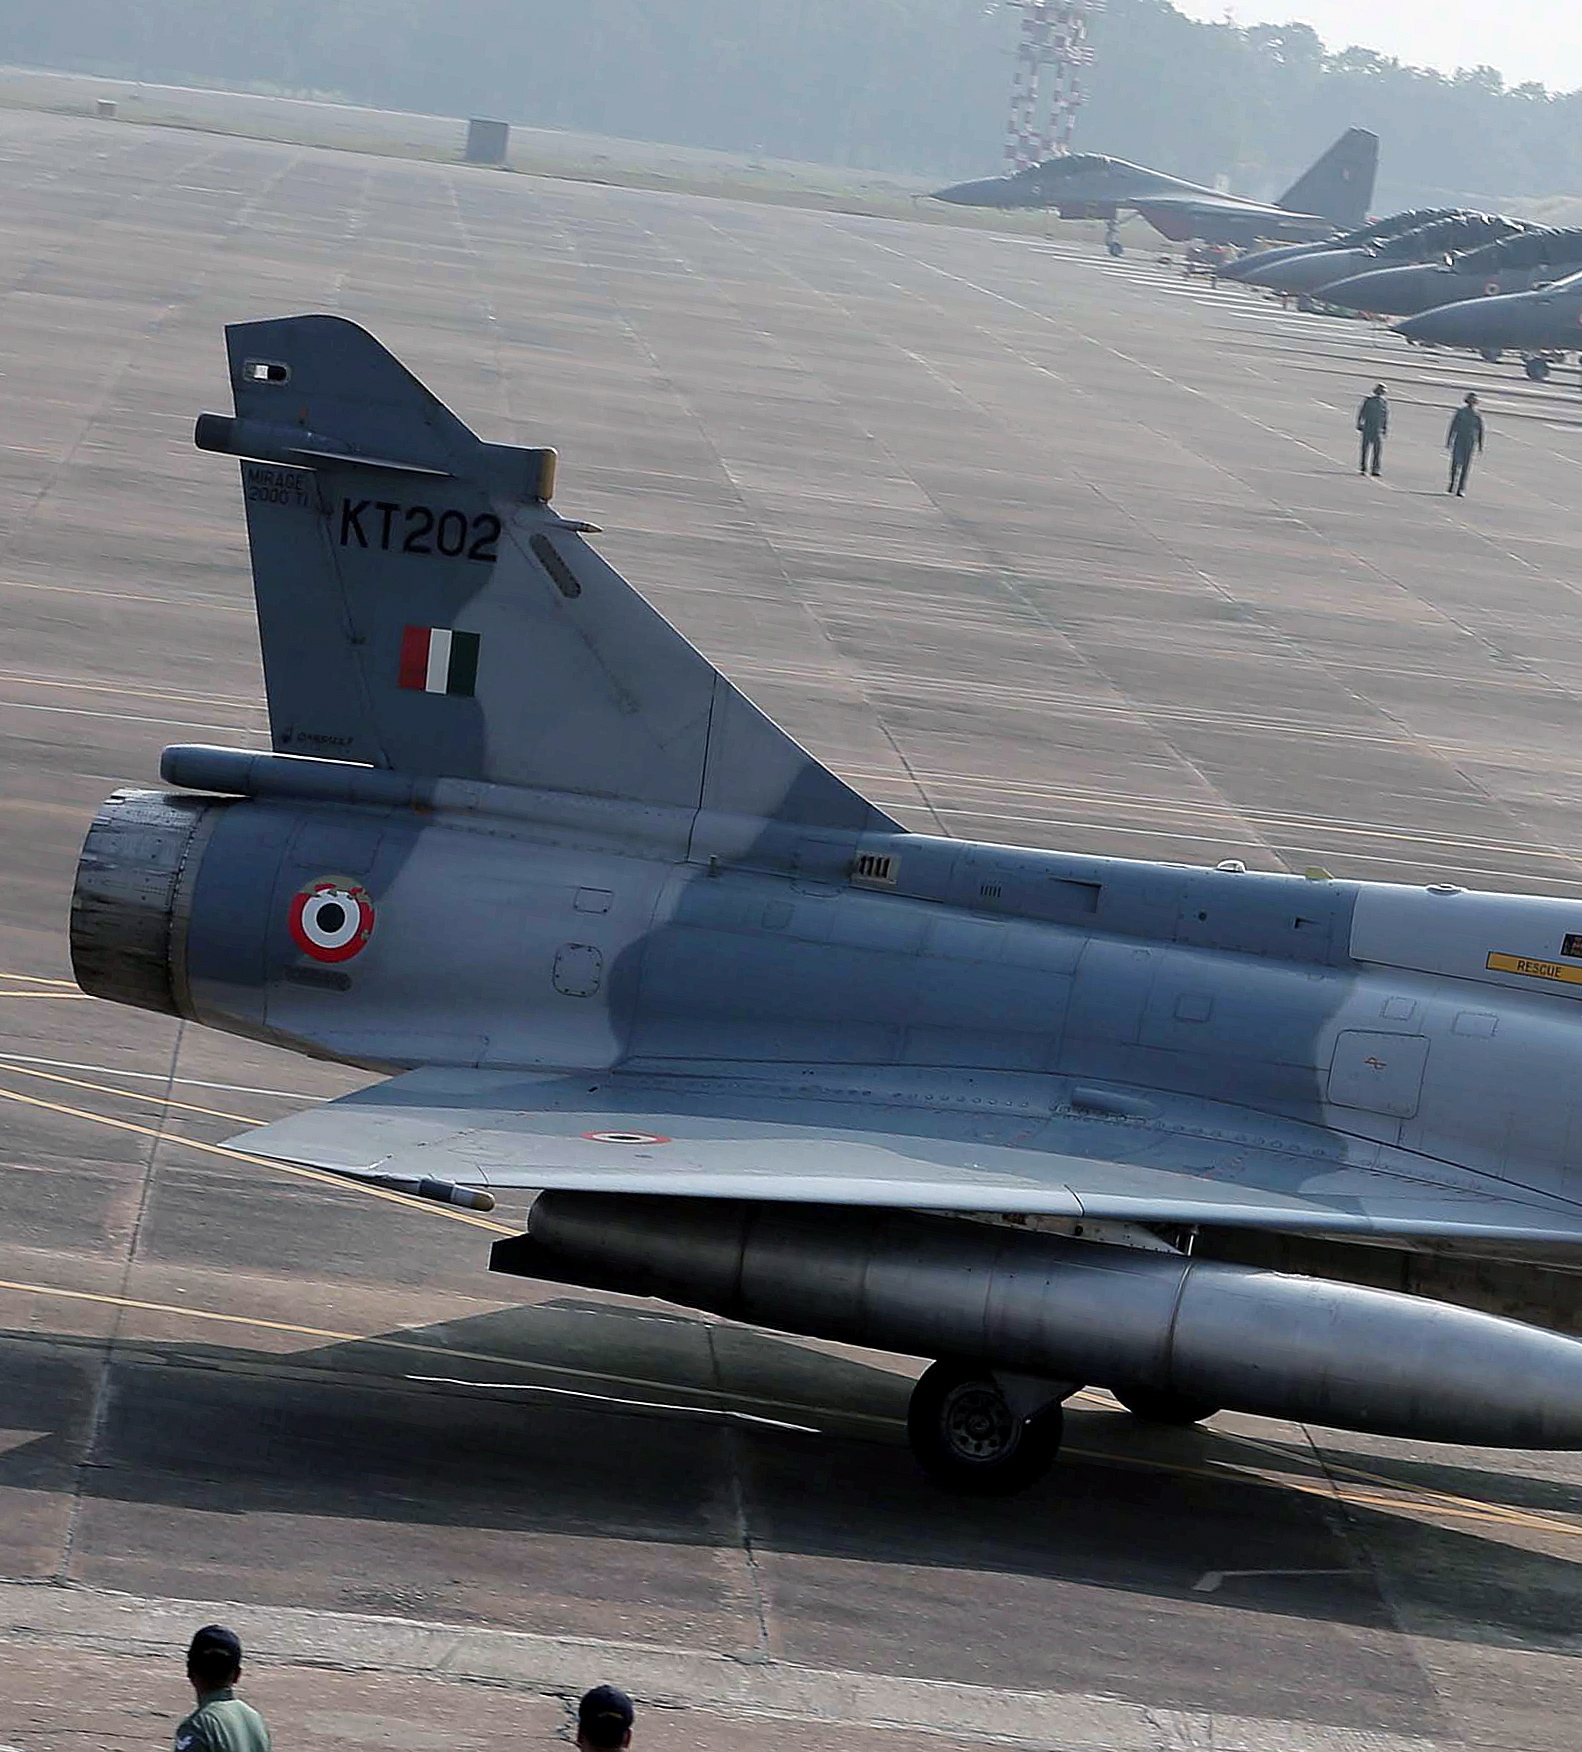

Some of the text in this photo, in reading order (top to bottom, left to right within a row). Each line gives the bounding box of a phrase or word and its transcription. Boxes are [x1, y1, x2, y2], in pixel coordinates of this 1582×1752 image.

[247, 468, 304, 490] MIRAGE
[248, 486, 290, 505] 2000
[340, 498, 502, 562] KT202
[1517, 960, 1564, 977] RESCUE
